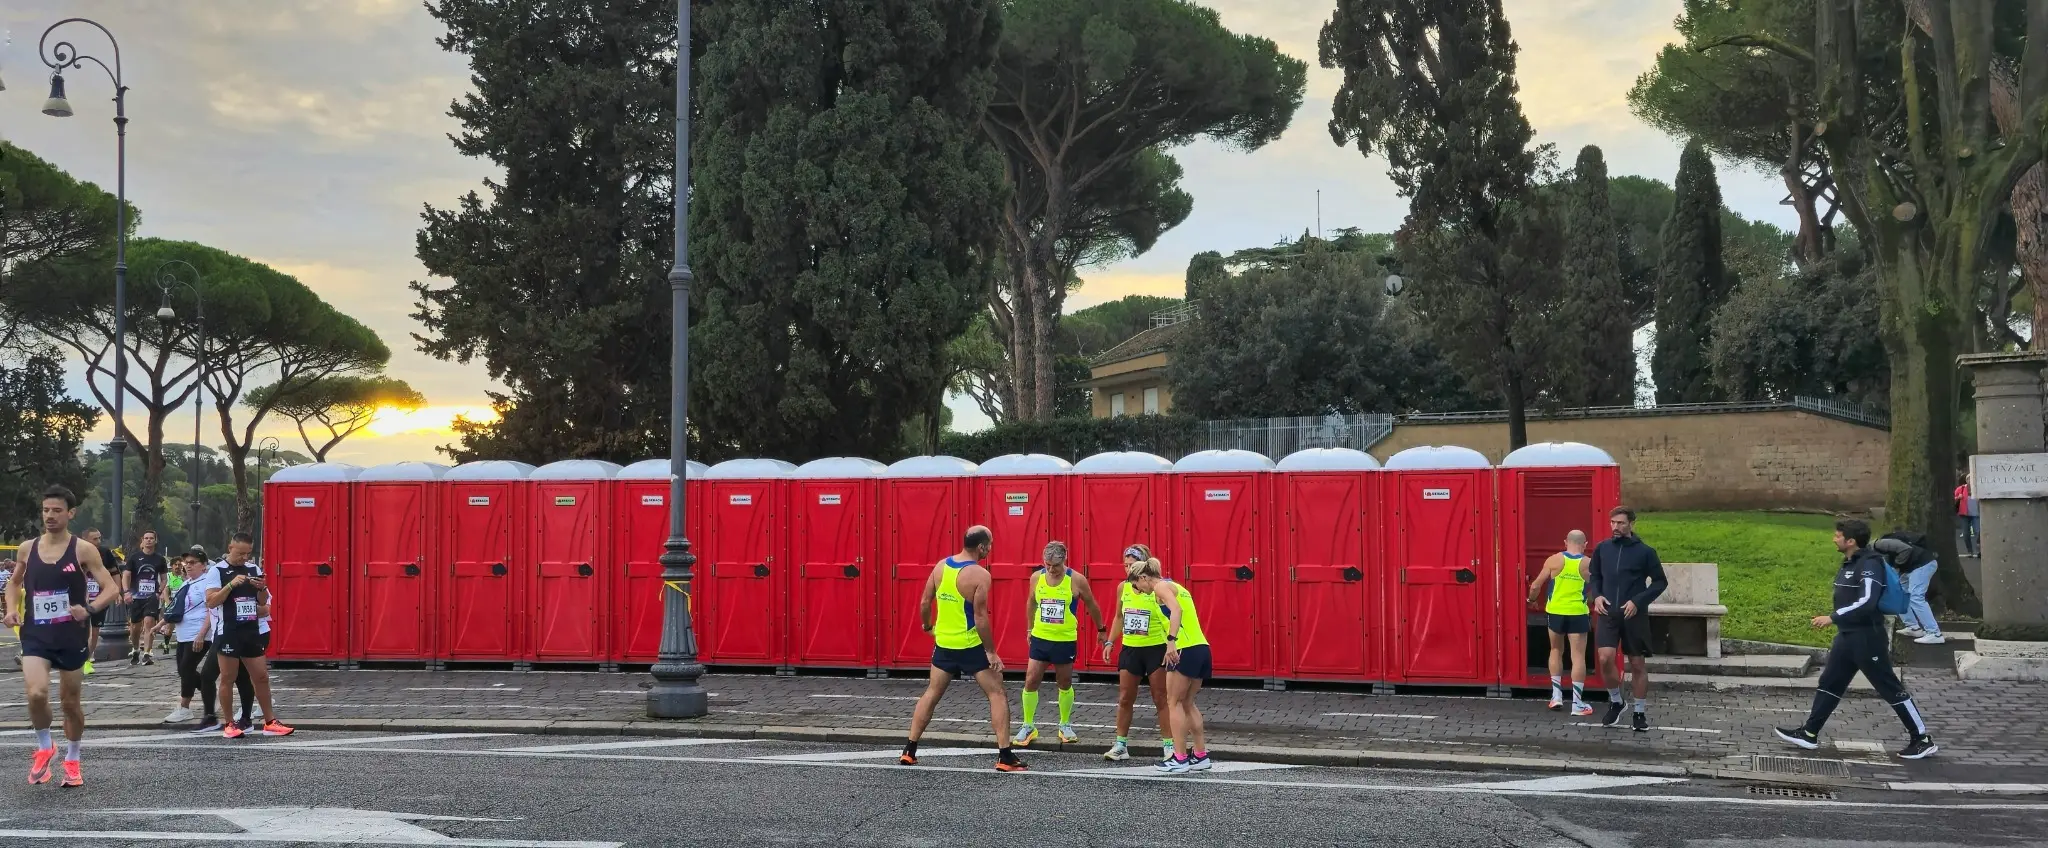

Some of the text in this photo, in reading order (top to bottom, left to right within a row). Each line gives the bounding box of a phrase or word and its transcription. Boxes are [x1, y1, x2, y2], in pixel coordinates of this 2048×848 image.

[1990, 464, 2036, 472] PIAZZALE
[43, 602, 58, 613] 95
[1046, 607, 1057, 616] 597
[1130, 618, 1142, 628] 595
